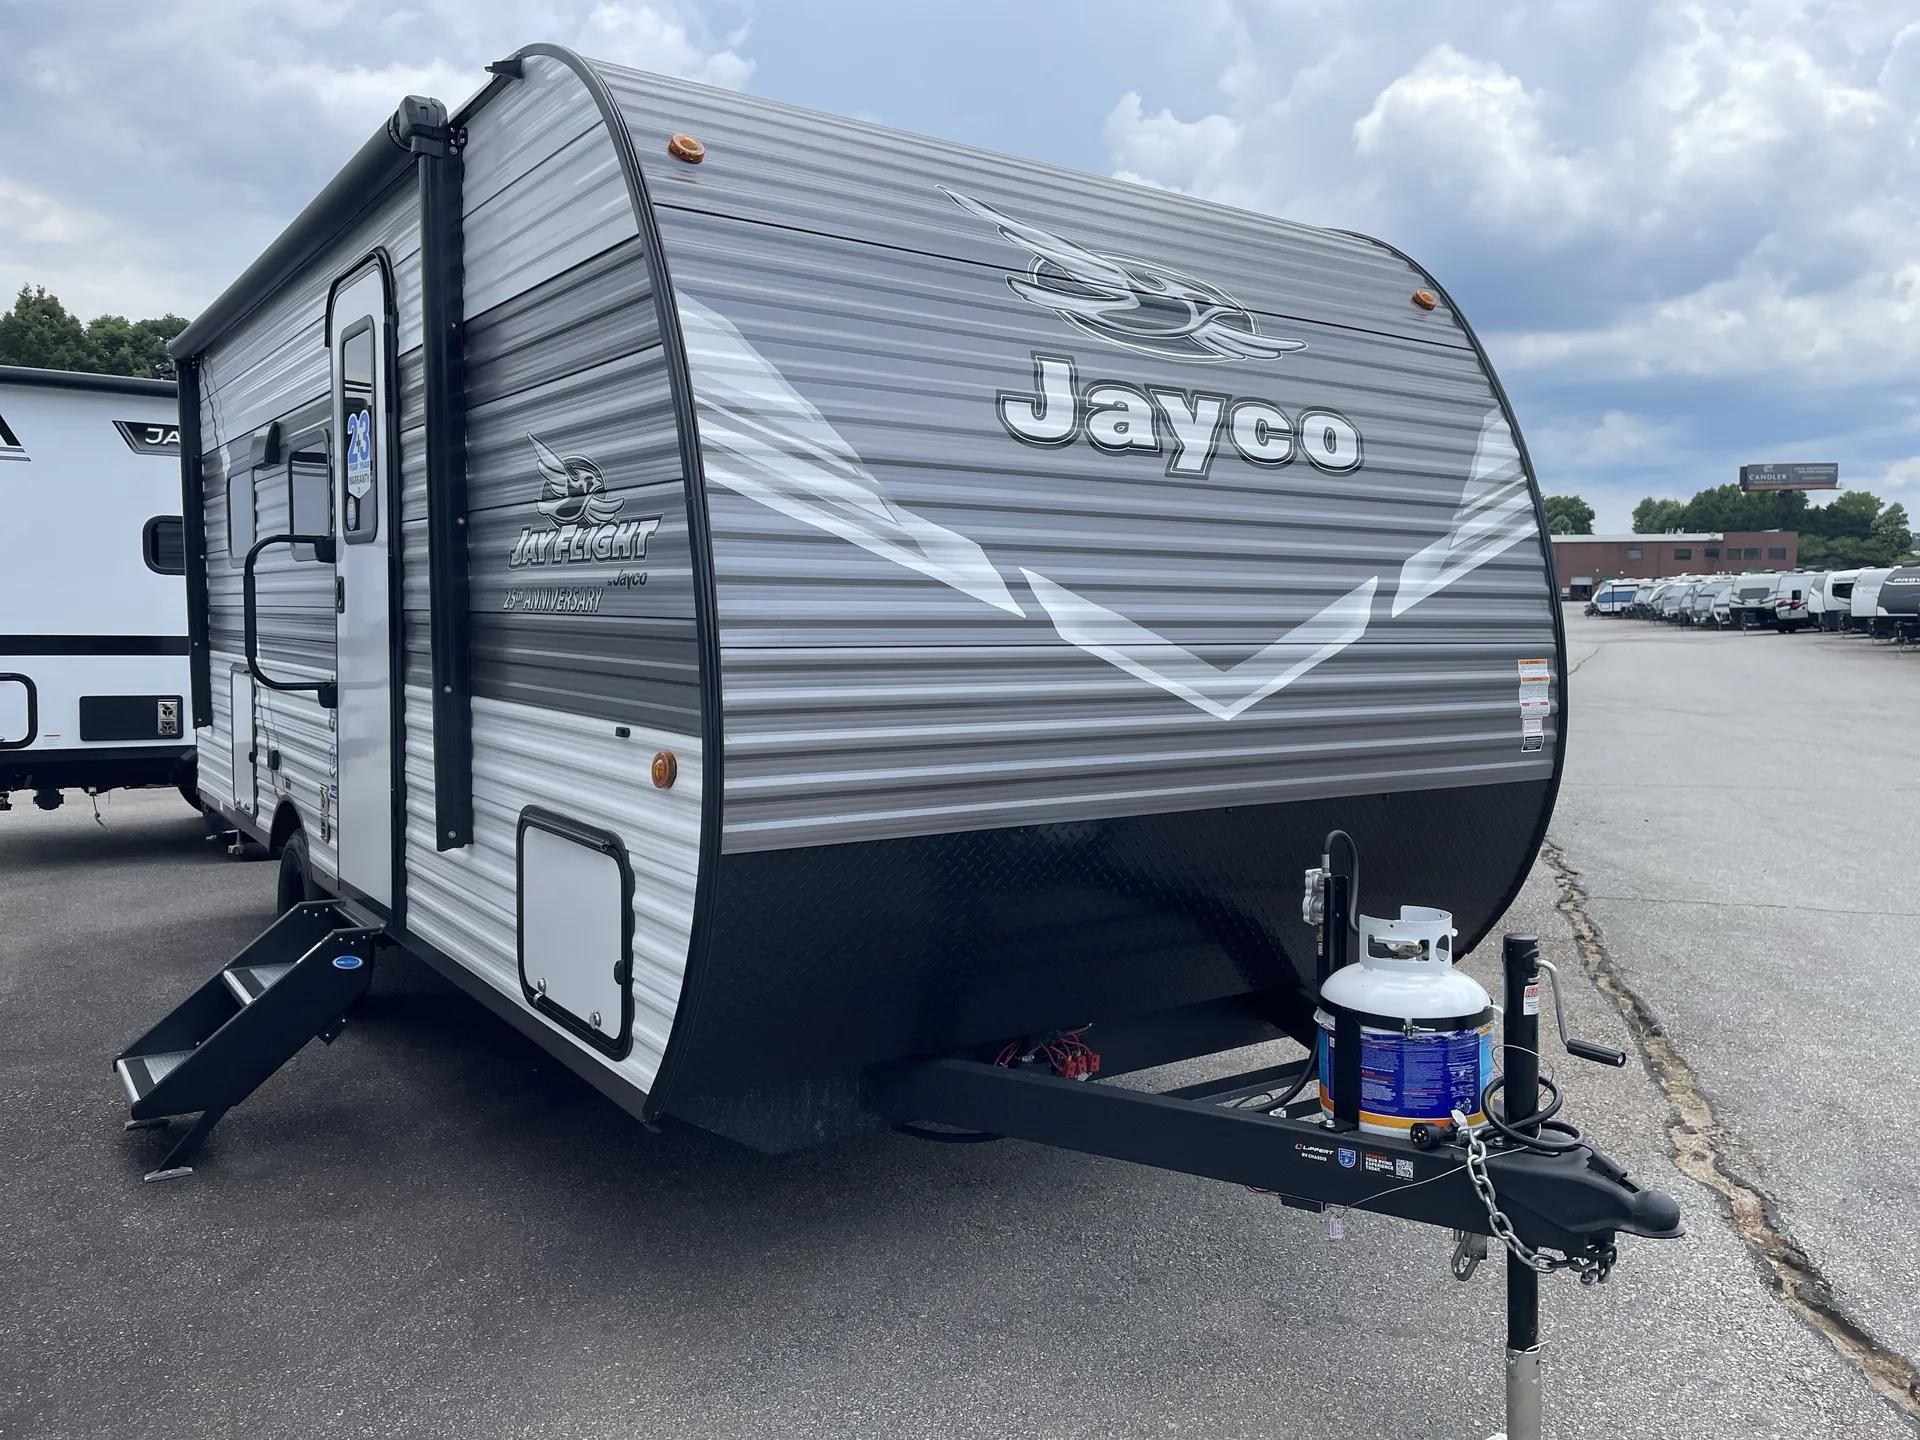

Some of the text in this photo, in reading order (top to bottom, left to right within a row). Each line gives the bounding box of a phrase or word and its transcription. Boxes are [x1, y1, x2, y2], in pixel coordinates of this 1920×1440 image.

[997, 352, 1362, 478] Jayco
[349, 473, 370, 486] WARRANTY
[509, 518, 660, 569] JAY FLIGHT
[613, 569, 648, 590] Jayco
[522, 586, 603, 613] ANNIVERSARY
[1302, 1145, 1334, 1155] LIPPERT
[1308, 1154, 1327, 1162] CHASSIS
[1365, 1161, 1394, 1171] EXPERIENCE
